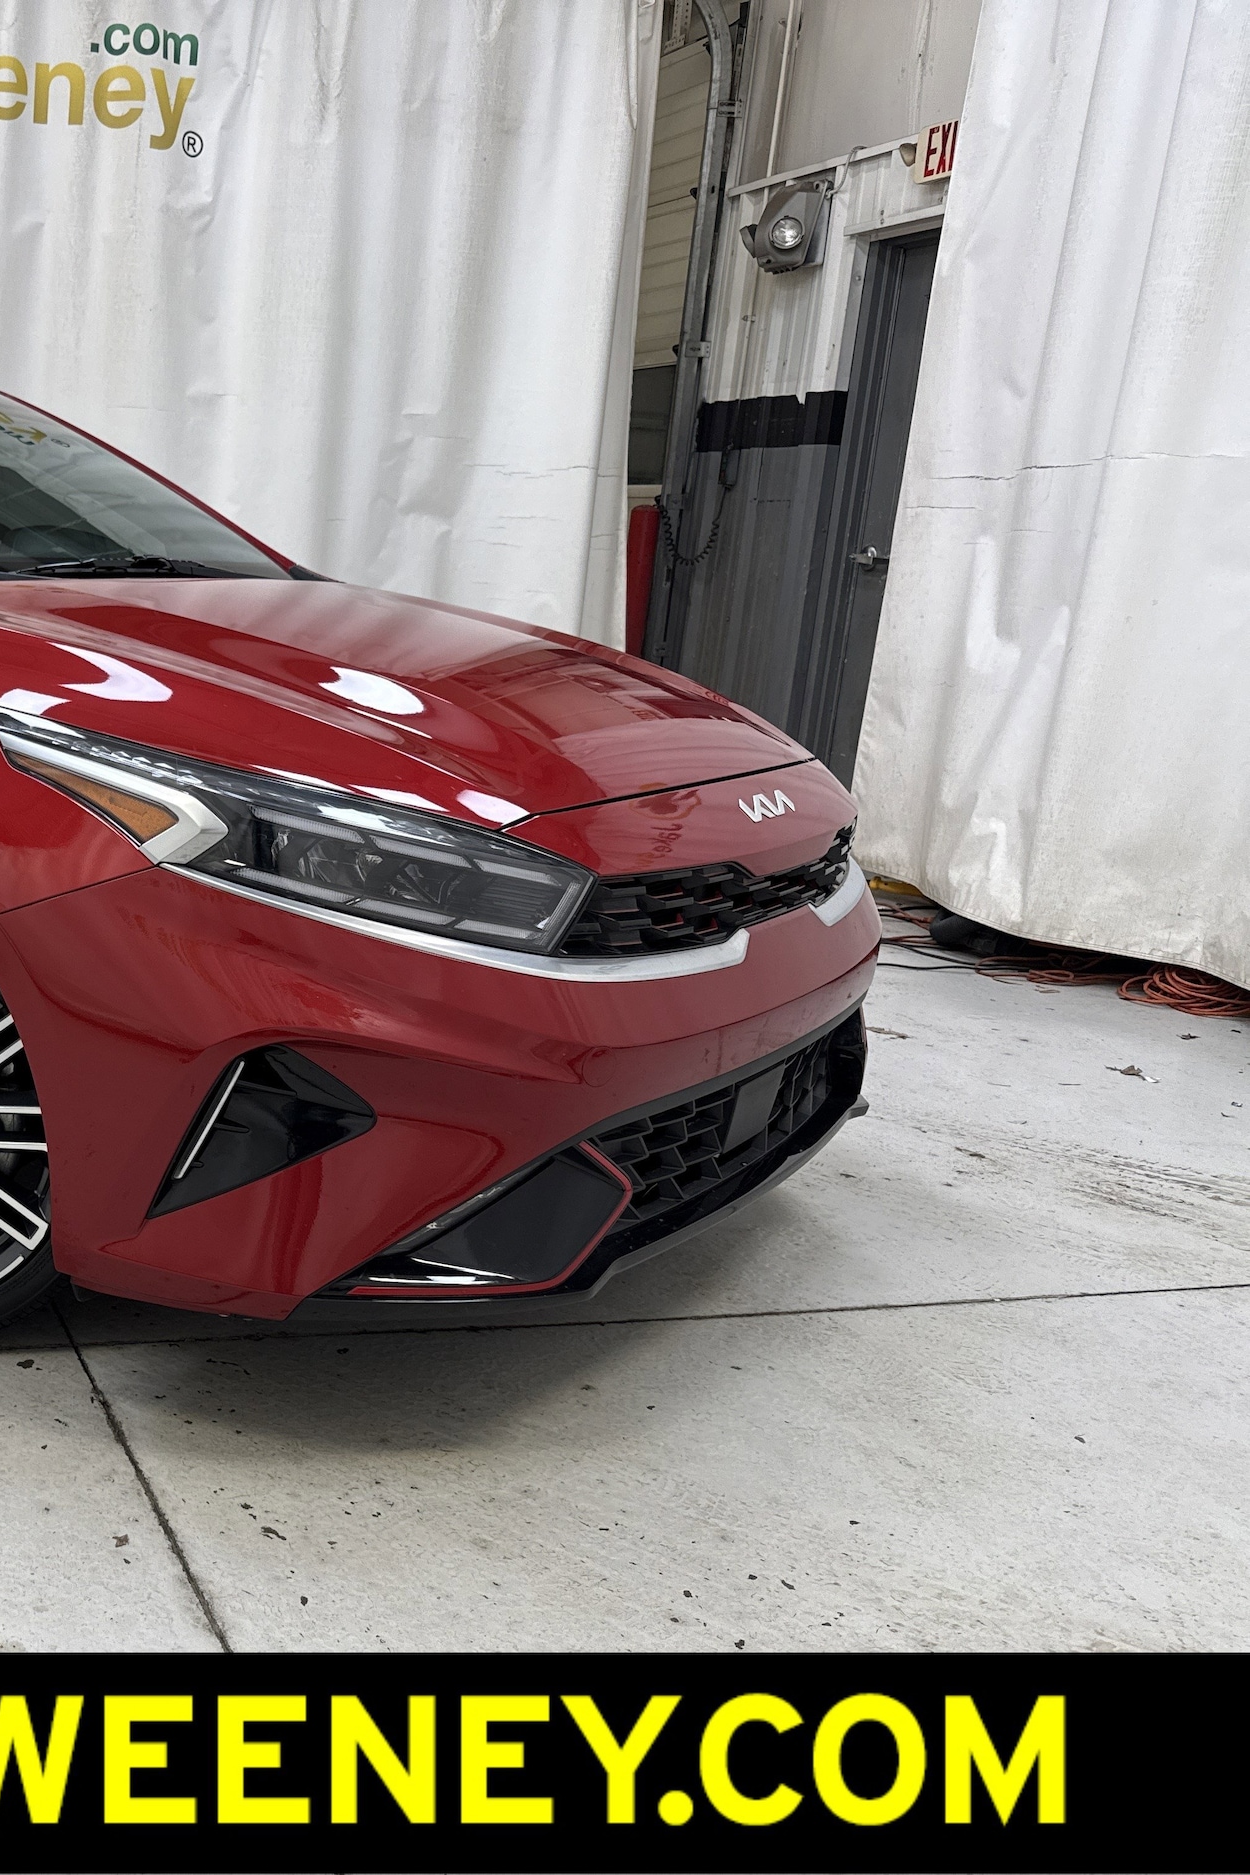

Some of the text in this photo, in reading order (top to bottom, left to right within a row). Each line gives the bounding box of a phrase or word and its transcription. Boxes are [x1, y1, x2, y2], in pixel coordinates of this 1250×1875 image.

[90, 22, 199, 66] .com
[923, 120, 959, 178] EXI
[738, 789, 796, 823] KIA
